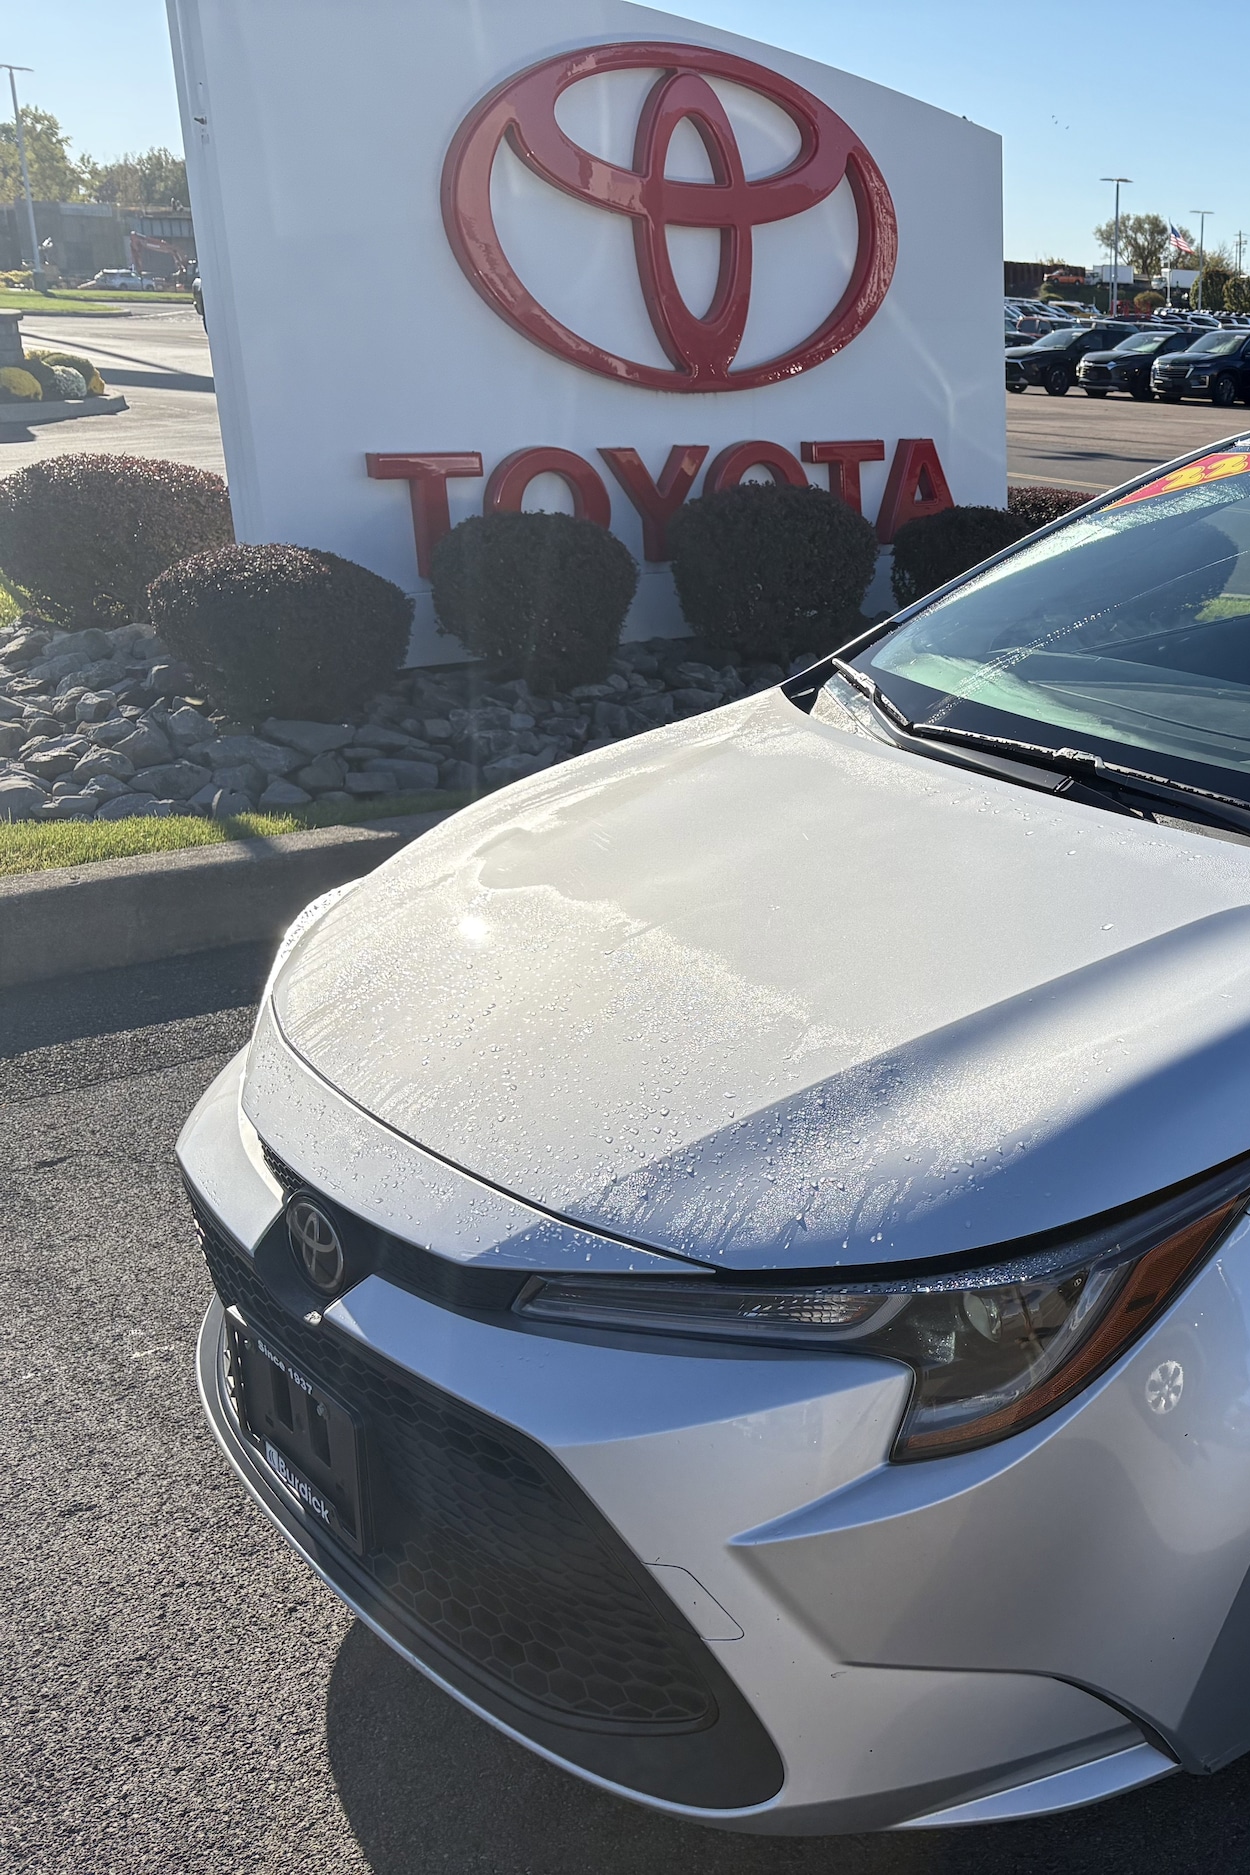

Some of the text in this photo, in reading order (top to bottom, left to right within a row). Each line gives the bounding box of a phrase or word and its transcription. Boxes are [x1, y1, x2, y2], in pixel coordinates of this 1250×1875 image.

[1162, 454, 1249, 491] 22
[257, 1340, 312, 1395] Since 1937
[277, 1454, 330, 1525] Burdick
